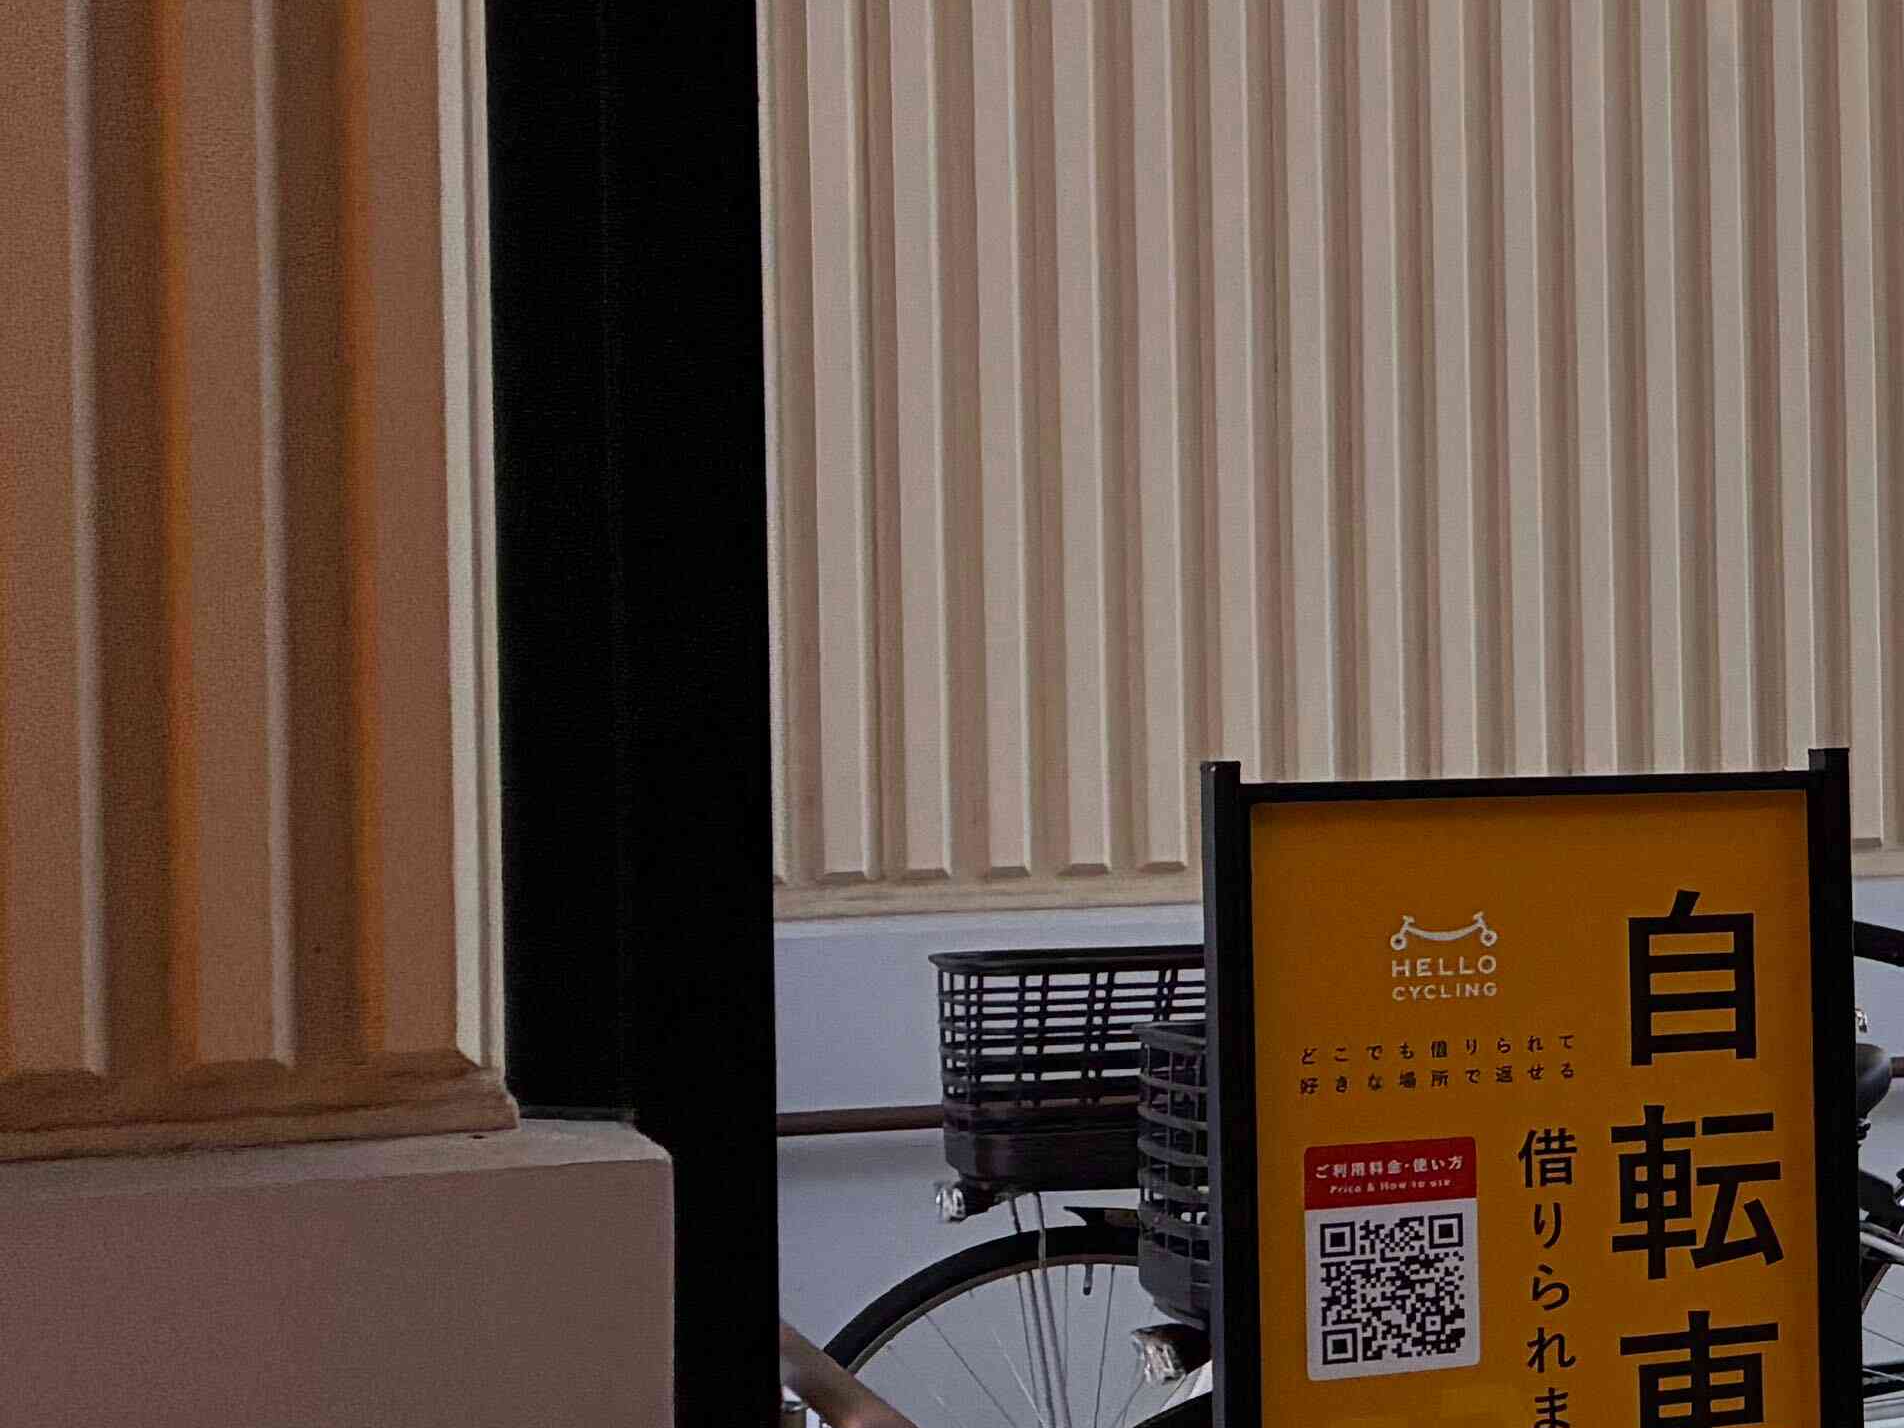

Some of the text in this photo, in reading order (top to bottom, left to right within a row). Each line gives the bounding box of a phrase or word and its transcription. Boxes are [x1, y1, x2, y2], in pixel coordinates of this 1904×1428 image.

[1391, 955, 1497, 978] HELLO
[1391, 981, 1498, 1002] CYCLING
[1300, 1033, 1575, 1065] どこでも借りられて
[1299, 1062, 1575, 1095] 好きな場所で返せる
